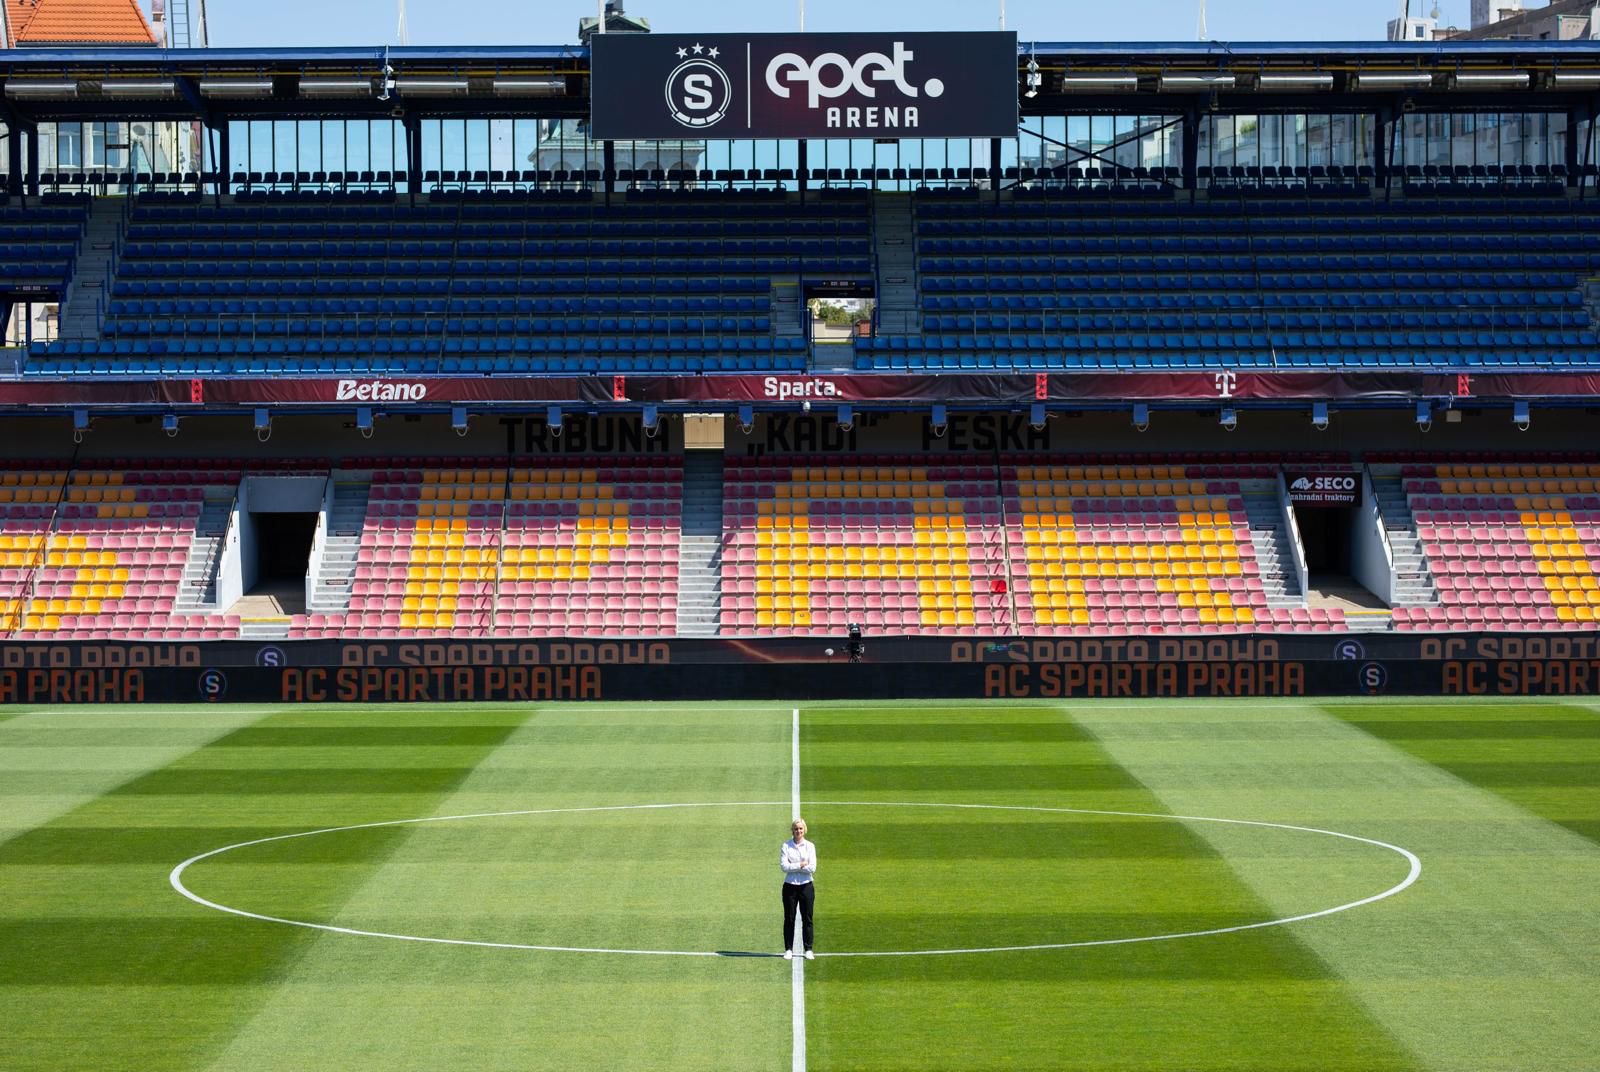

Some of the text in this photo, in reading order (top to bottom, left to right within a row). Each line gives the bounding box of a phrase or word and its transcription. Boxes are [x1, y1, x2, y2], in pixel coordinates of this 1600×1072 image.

[684, 74, 713, 110] S
[827, 107, 918, 128] ARENA
[336, 380, 427, 400] Betano
[764, 377, 843, 401] Sparta.
[499, 417, 669, 453] TRIBUNA
[1315, 477, 1355, 490] SECO
[1325, 493, 1355, 502] traktory
[1476, 637, 1600, 660] SPART
[27, 668, 145, 702] PRAHA
[281, 666, 603, 702] AC SPARTA PRAHA
[984, 662, 1305, 697] AC SPARTA PRAHA
[1442, 661, 1488, 695] AC
